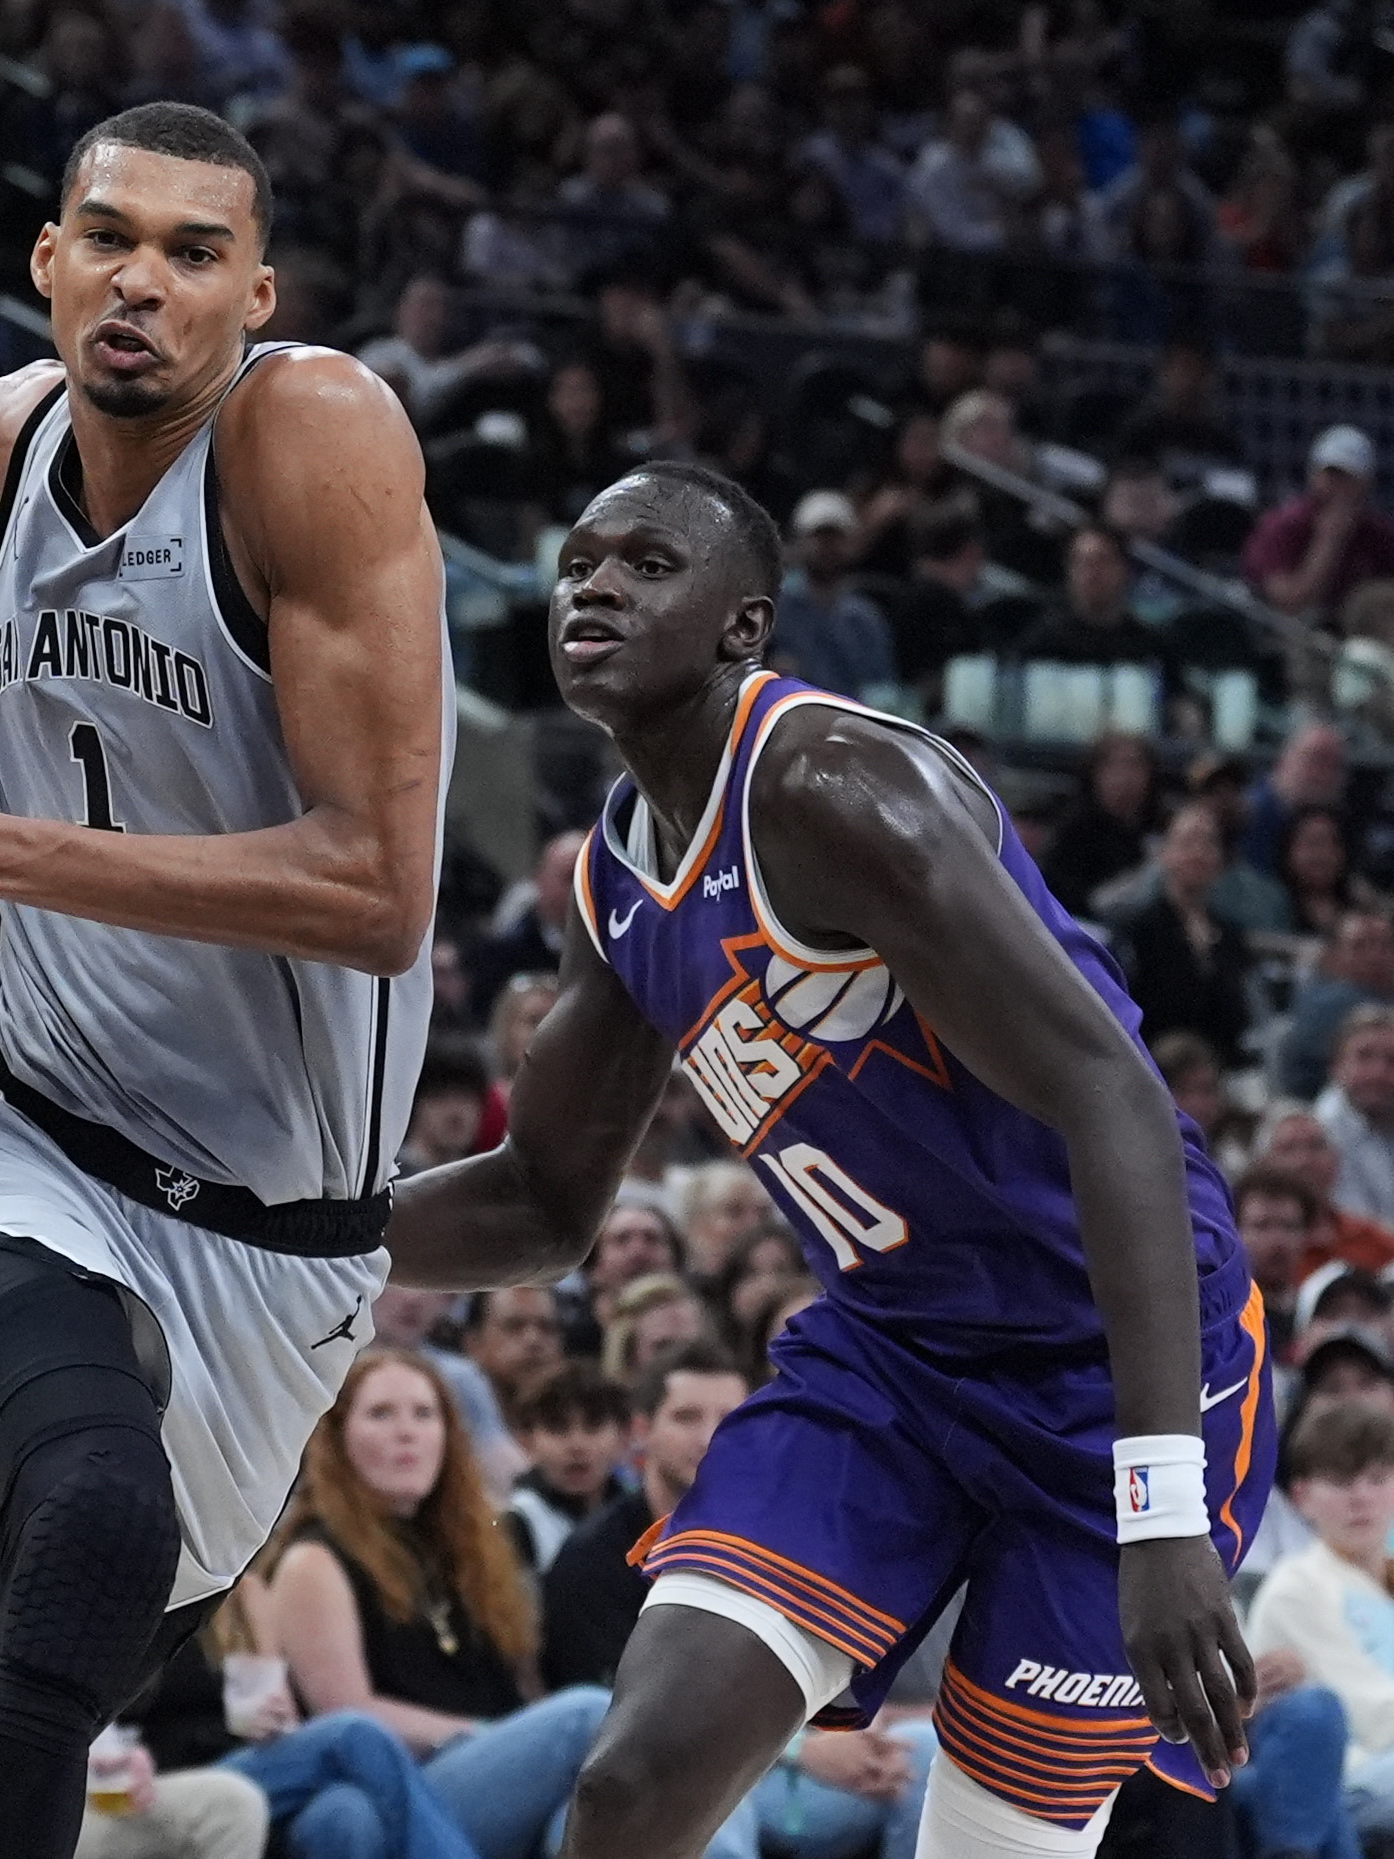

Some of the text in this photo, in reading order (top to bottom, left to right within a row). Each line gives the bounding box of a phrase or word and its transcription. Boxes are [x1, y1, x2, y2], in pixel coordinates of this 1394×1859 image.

[24, 608, 215, 730] ANTONIO
[67, 720, 127, 834] 1
[678, 998, 803, 1146] UNS
[757, 1141, 909, 1271] 10
